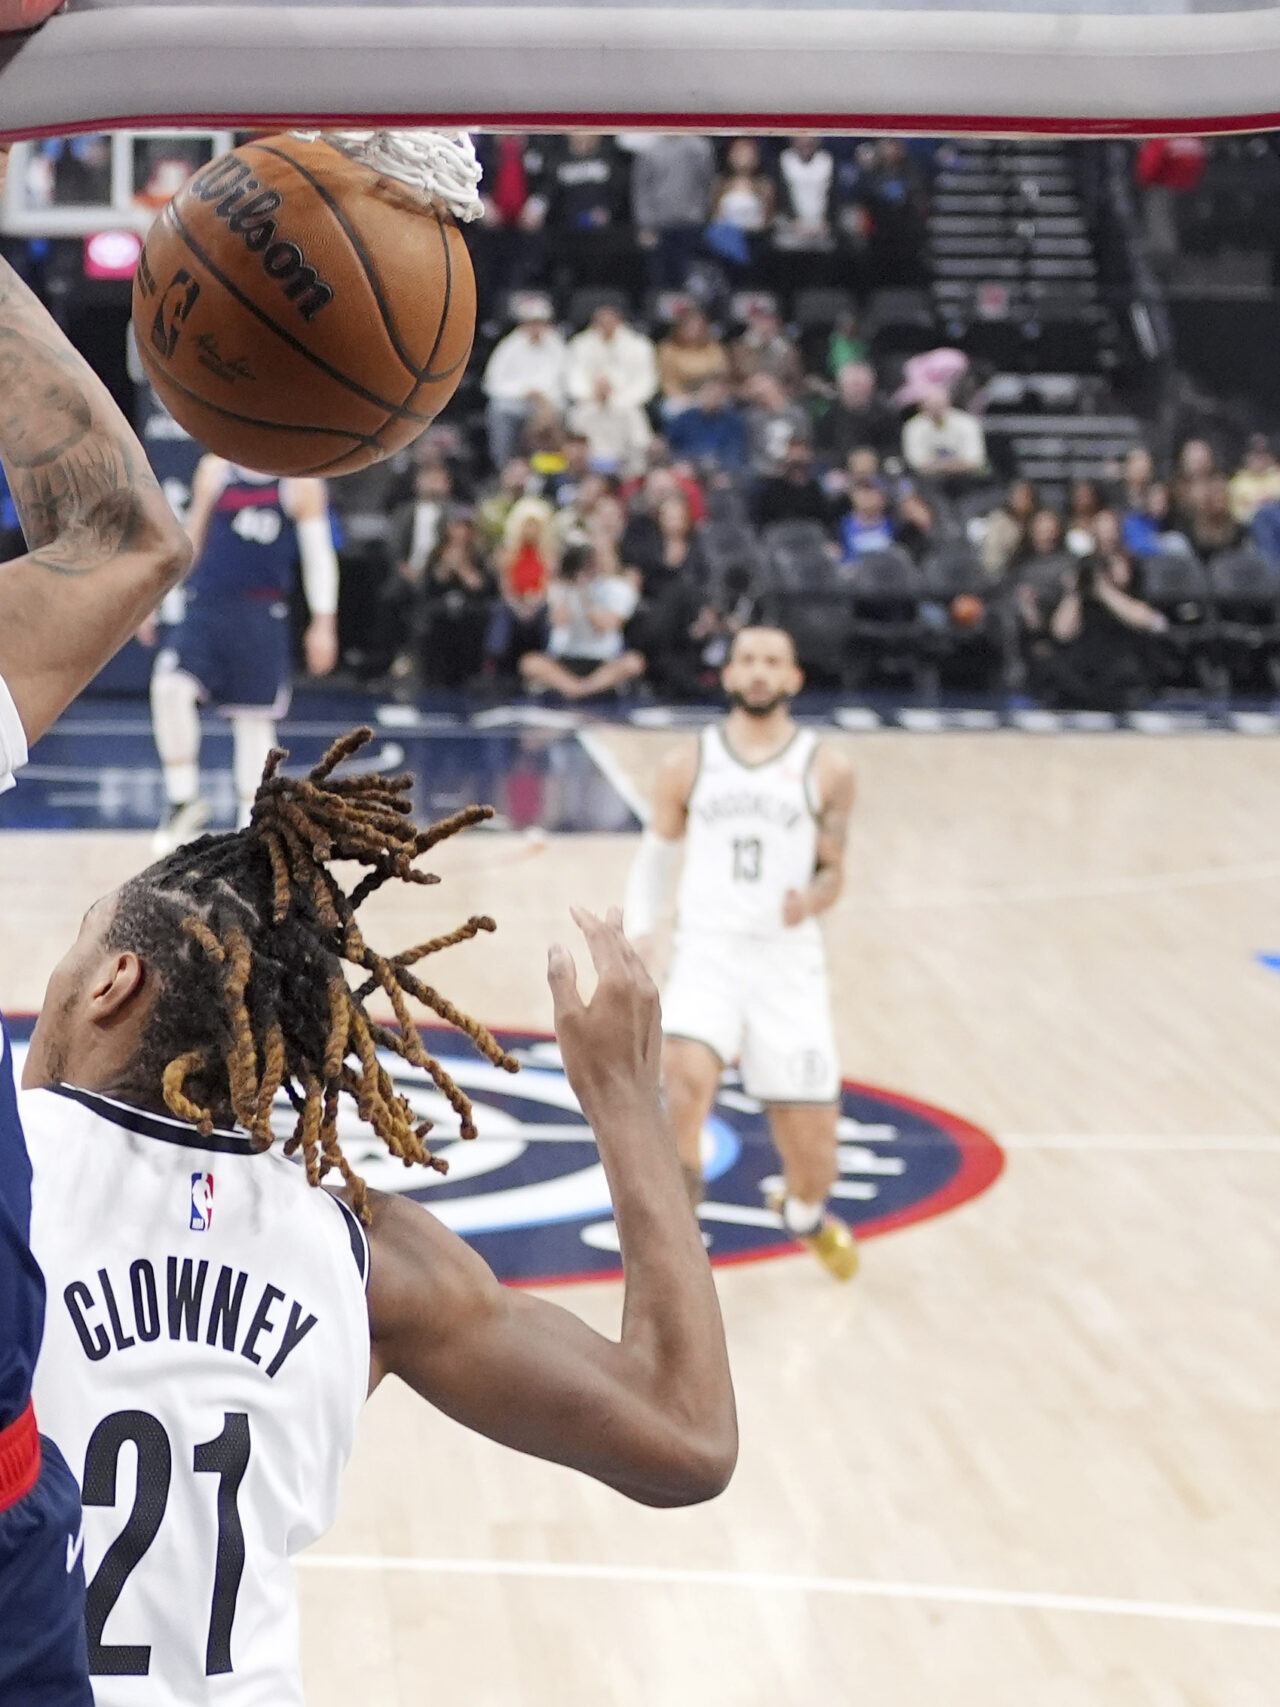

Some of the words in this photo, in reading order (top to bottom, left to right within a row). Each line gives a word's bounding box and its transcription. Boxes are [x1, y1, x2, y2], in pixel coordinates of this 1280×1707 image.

[191, 154, 333, 323] Wilson
[732, 836, 762, 882] 13
[63, 1256, 318, 1379] CLOWNEY
[81, 1409, 251, 1676] 21
